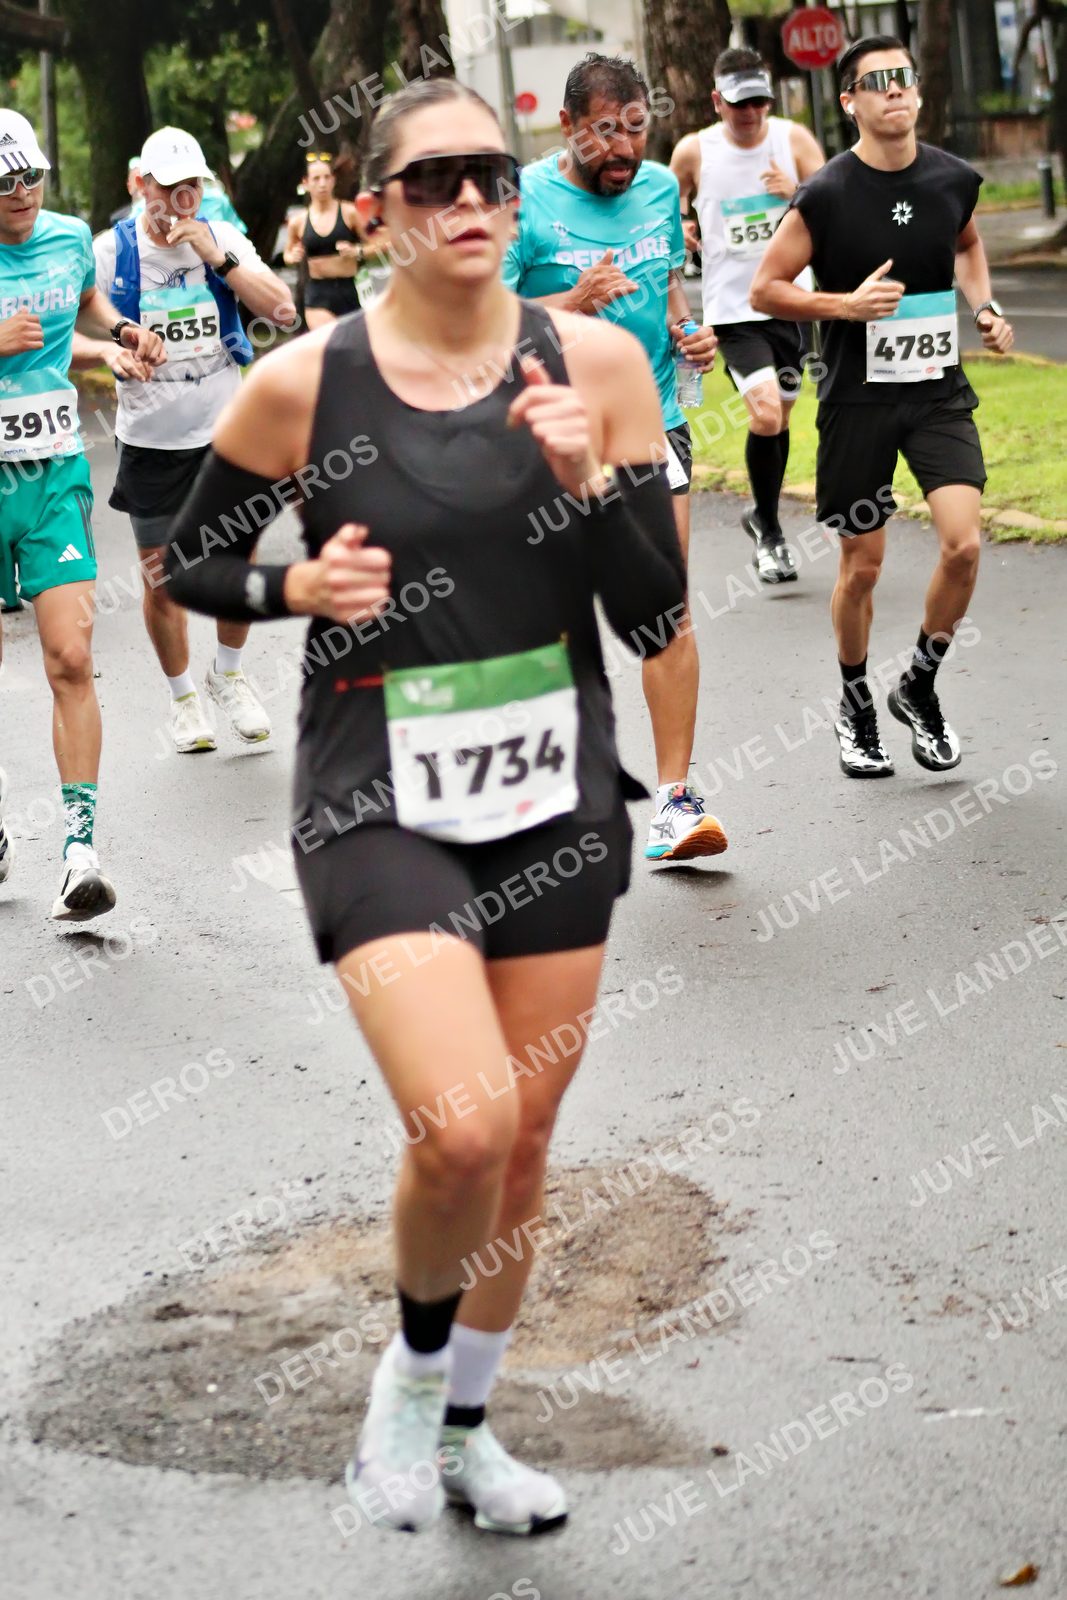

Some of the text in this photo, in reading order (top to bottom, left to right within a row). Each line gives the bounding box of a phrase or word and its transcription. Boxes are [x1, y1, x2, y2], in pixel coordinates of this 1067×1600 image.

[788, 24, 838, 51] ALTO
[0, 284, 78, 319] RDURA
[149, 315, 218, 343] 6635
[874, 331, 952, 361] 4783
[0, 405, 72, 441] 3916
[414, 728, 566, 800] 1734
